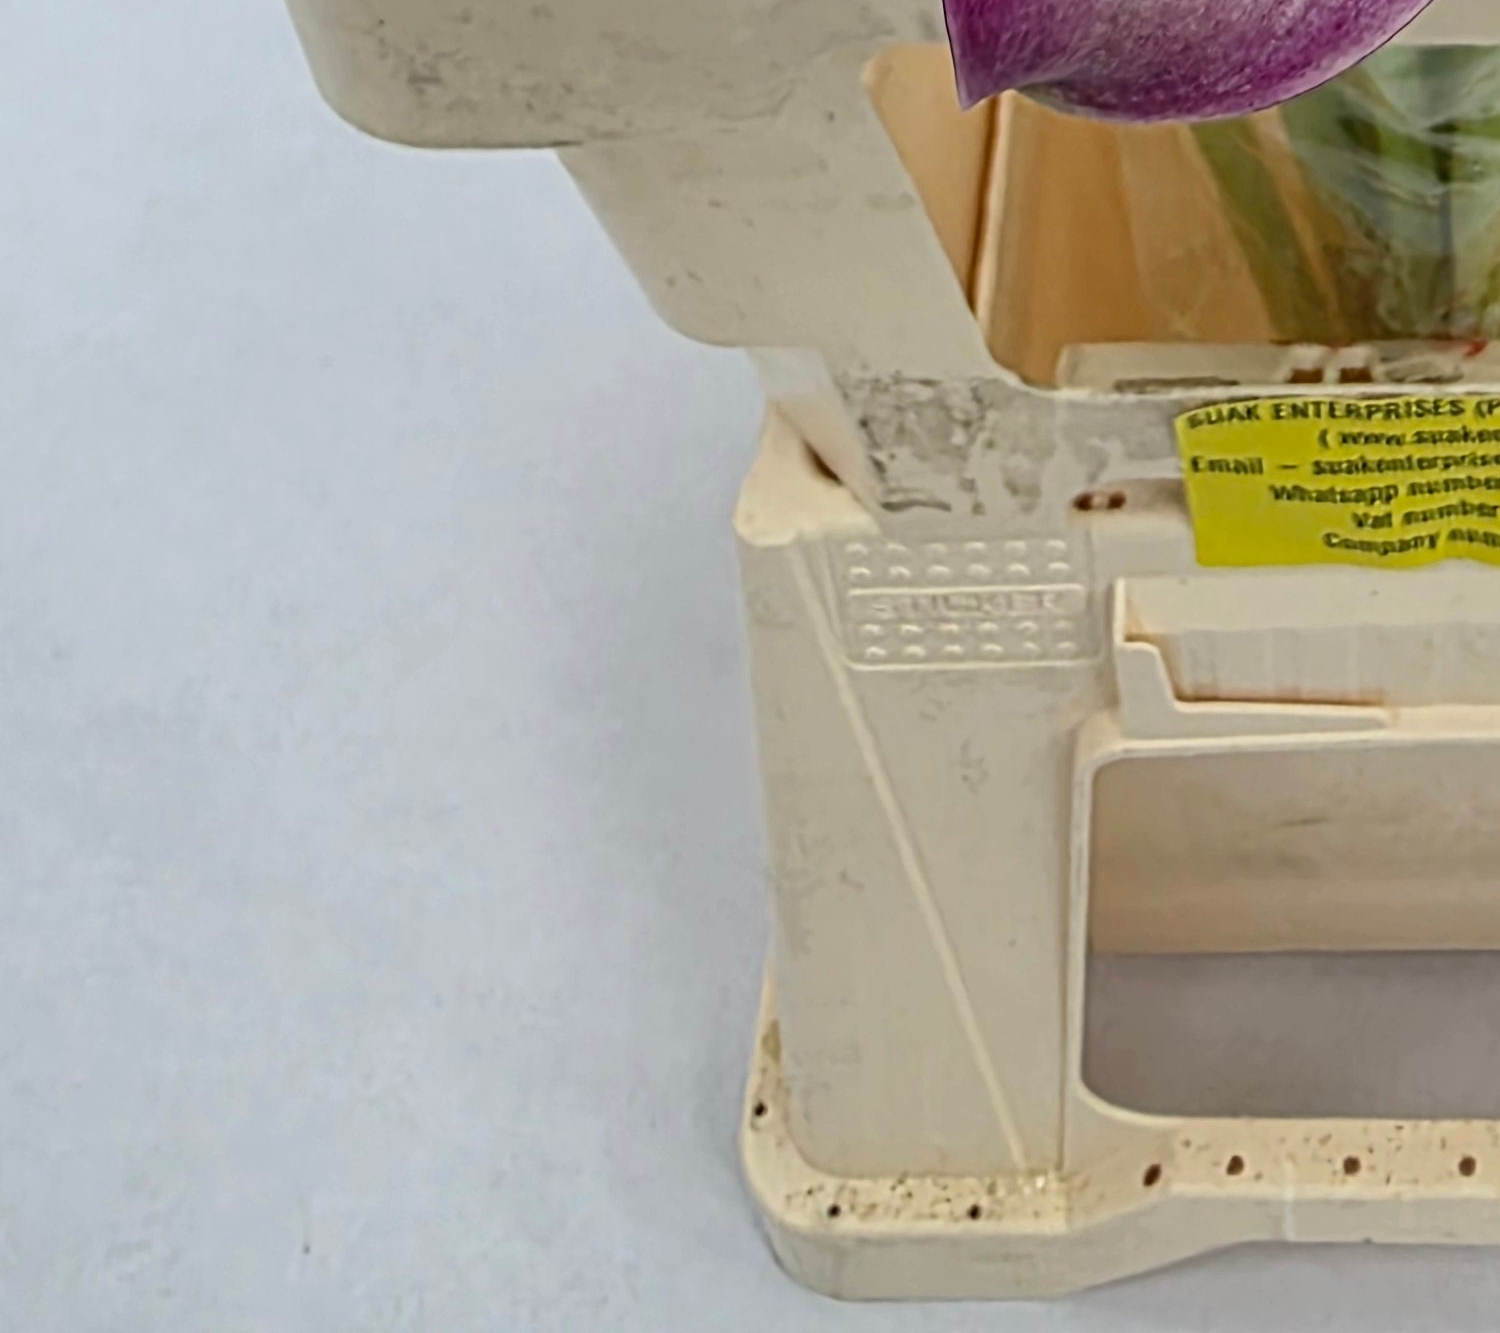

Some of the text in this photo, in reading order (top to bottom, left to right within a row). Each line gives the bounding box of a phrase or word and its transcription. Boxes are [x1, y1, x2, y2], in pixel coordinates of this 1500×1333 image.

[1186, 403, 1261, 429] SUAK
[1271, 398, 1465, 421] ENTERPRISES
[1189, 454, 1264, 475] Email
[1268, 483, 1399, 506] Whatsapp
[1321, 531, 1441, 557] Company
